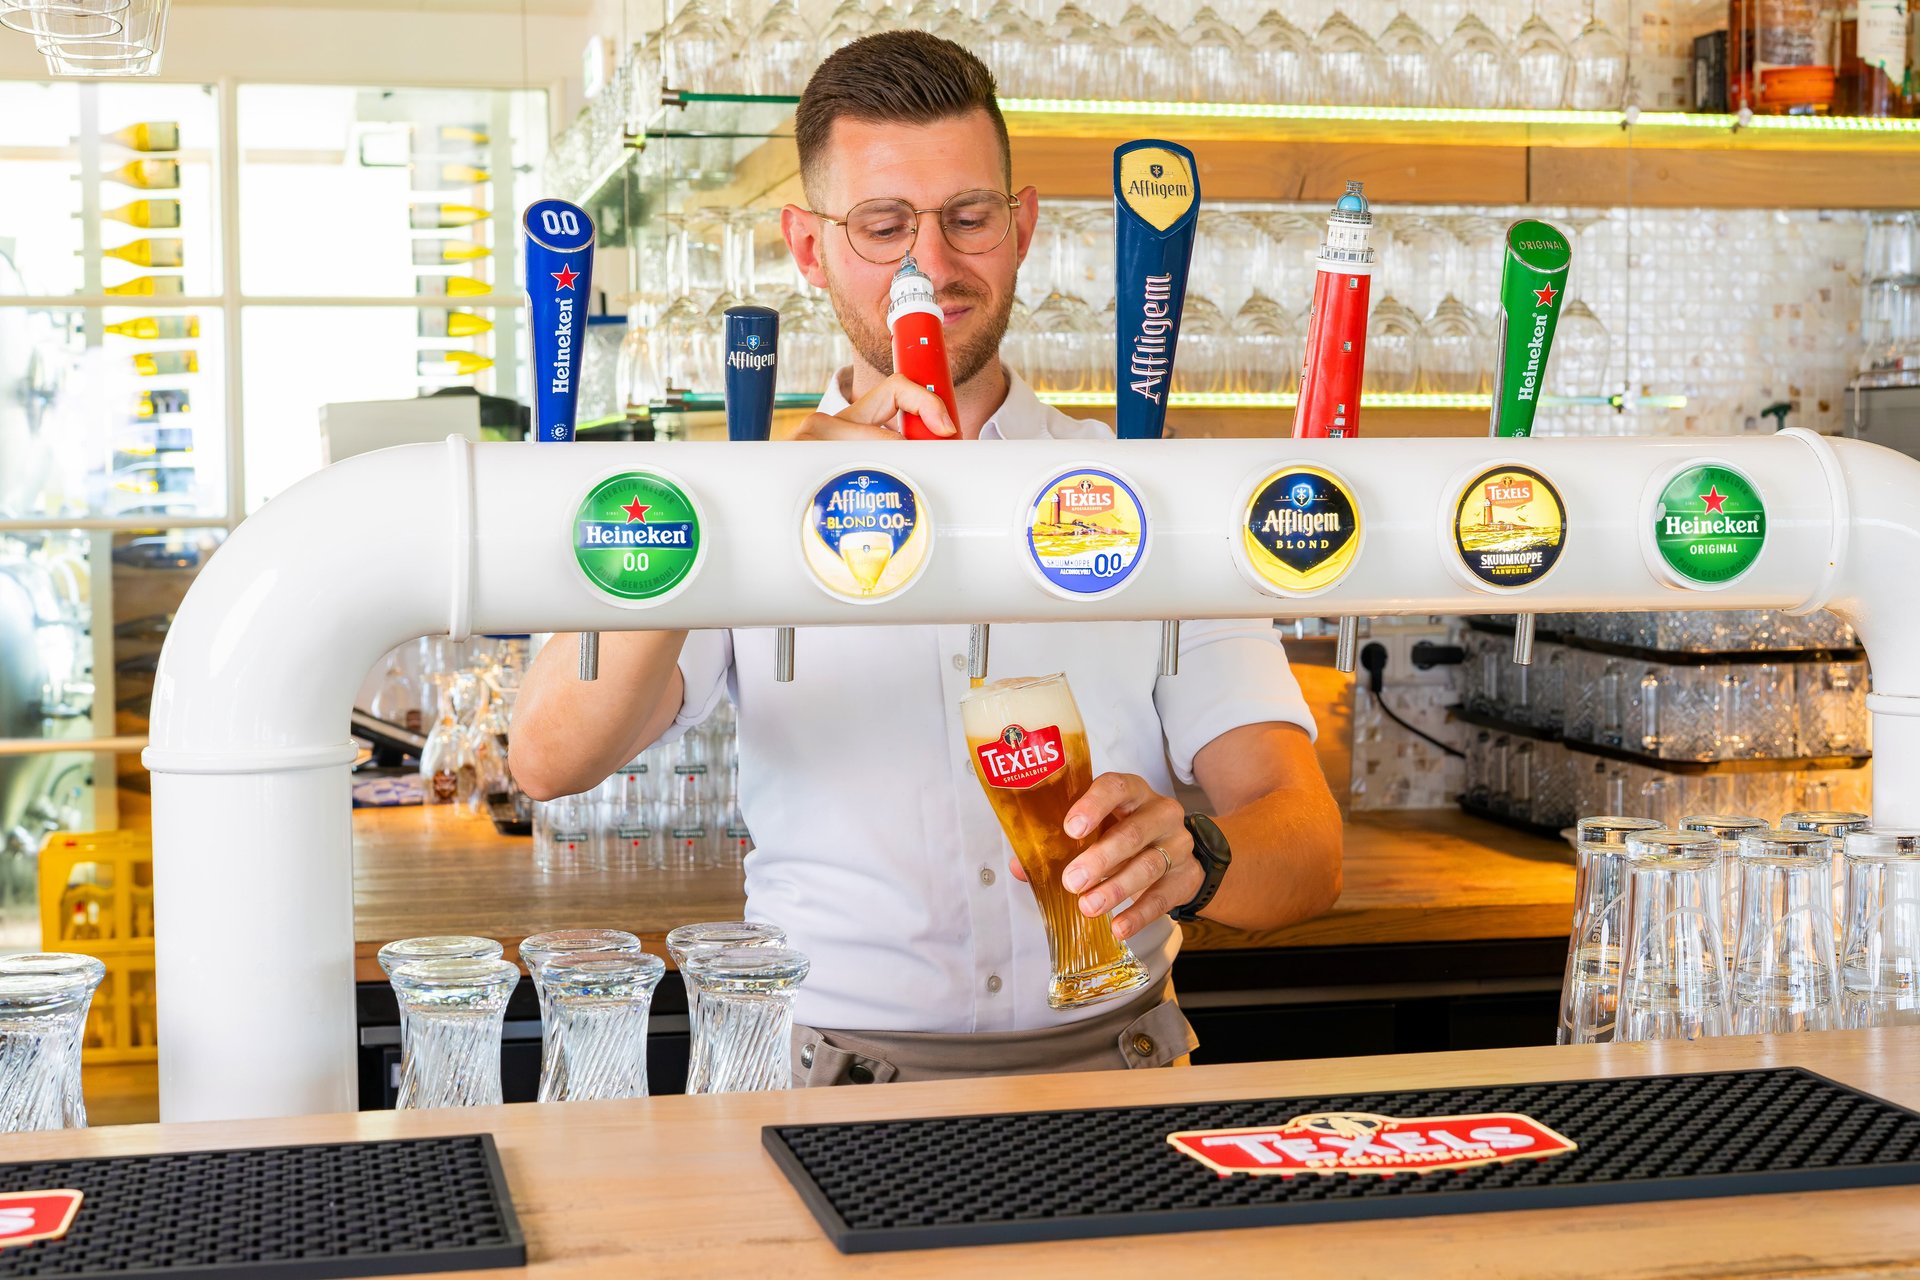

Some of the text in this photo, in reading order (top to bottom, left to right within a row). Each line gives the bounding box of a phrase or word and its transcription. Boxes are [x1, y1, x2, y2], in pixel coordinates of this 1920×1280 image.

[1128, 179, 1187, 199] Affligem
[541, 209, 580, 236] 0.0
[1518, 239, 1563, 250] ORIGINAL
[552, 297, 573, 394] Heineken
[1130, 272, 1173, 406] Affligem
[727, 351, 776, 370] Affligem
[1518, 313, 1548, 401] Heineken
[826, 489, 903, 514] Affligem
[1060, 489, 1112, 507] TEXELS
[1487, 485, 1531, 501] TEXELS
[826, 515, 876, 529] BLOND
[879, 513, 905, 529] 0.0
[1261, 509, 1341, 537] Affligem
[1665, 516, 1759, 535] Heineken
[585, 525, 687, 544] Heineken
[1276, 540, 1330, 549] BLOND
[1689, 543, 1738, 555] ORIGINAL
[623, 552, 649, 572] 0.0
[1094, 553, 1122, 575] 0.0
[1480, 552, 1543, 566] SKUUMKOPPE
[981, 741, 1059, 778] TEXELS
[1003, 766, 1048, 783] SPECIAALBIER
[1202, 1126, 1536, 1164] TEXELS
